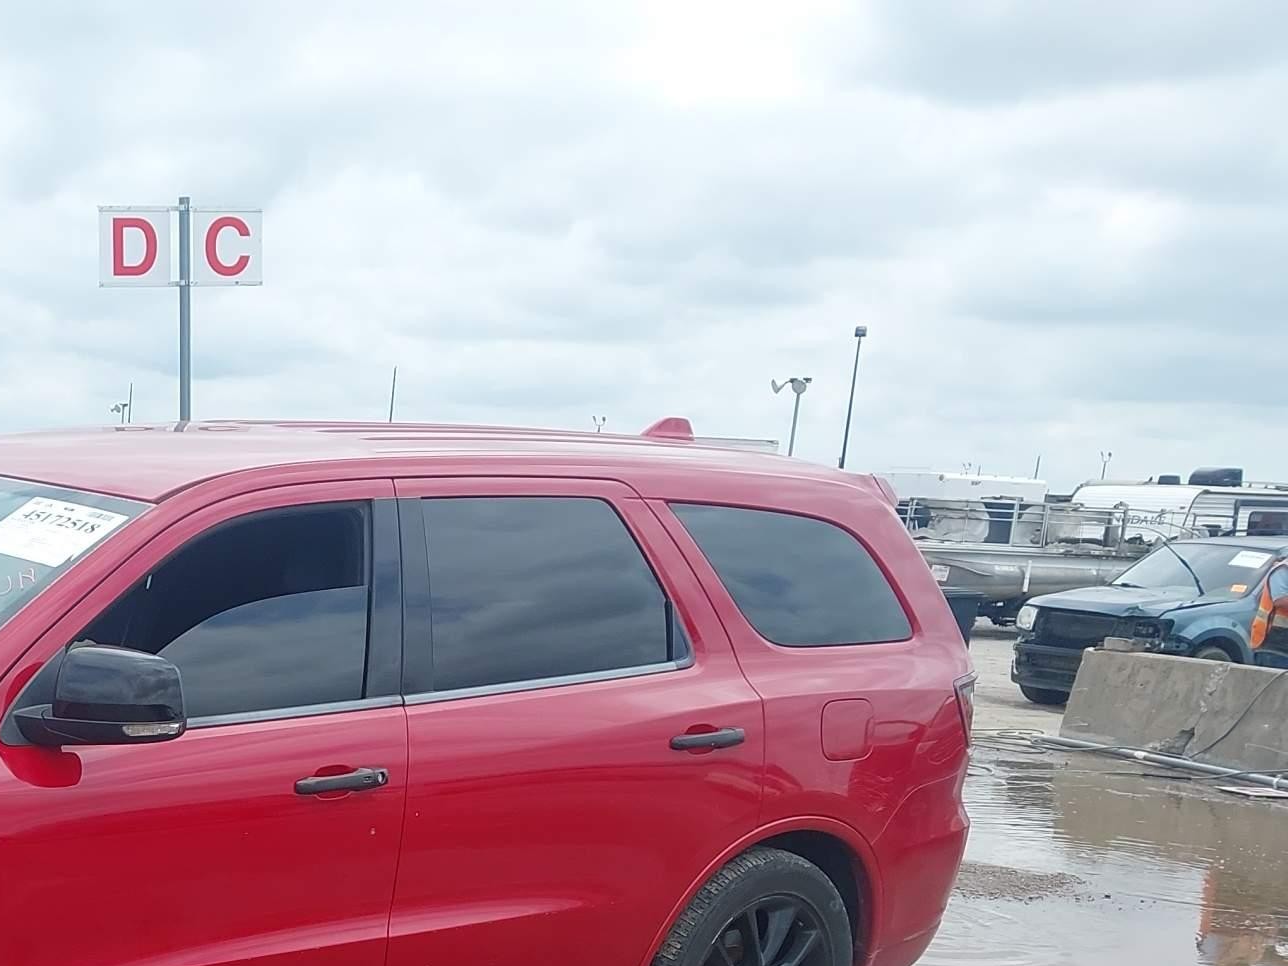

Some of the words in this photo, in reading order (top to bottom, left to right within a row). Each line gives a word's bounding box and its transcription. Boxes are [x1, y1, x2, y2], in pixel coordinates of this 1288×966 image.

[112, 217, 158, 277] D
[205, 216, 251, 277] C
[22, 509, 101, 534] 45172518
